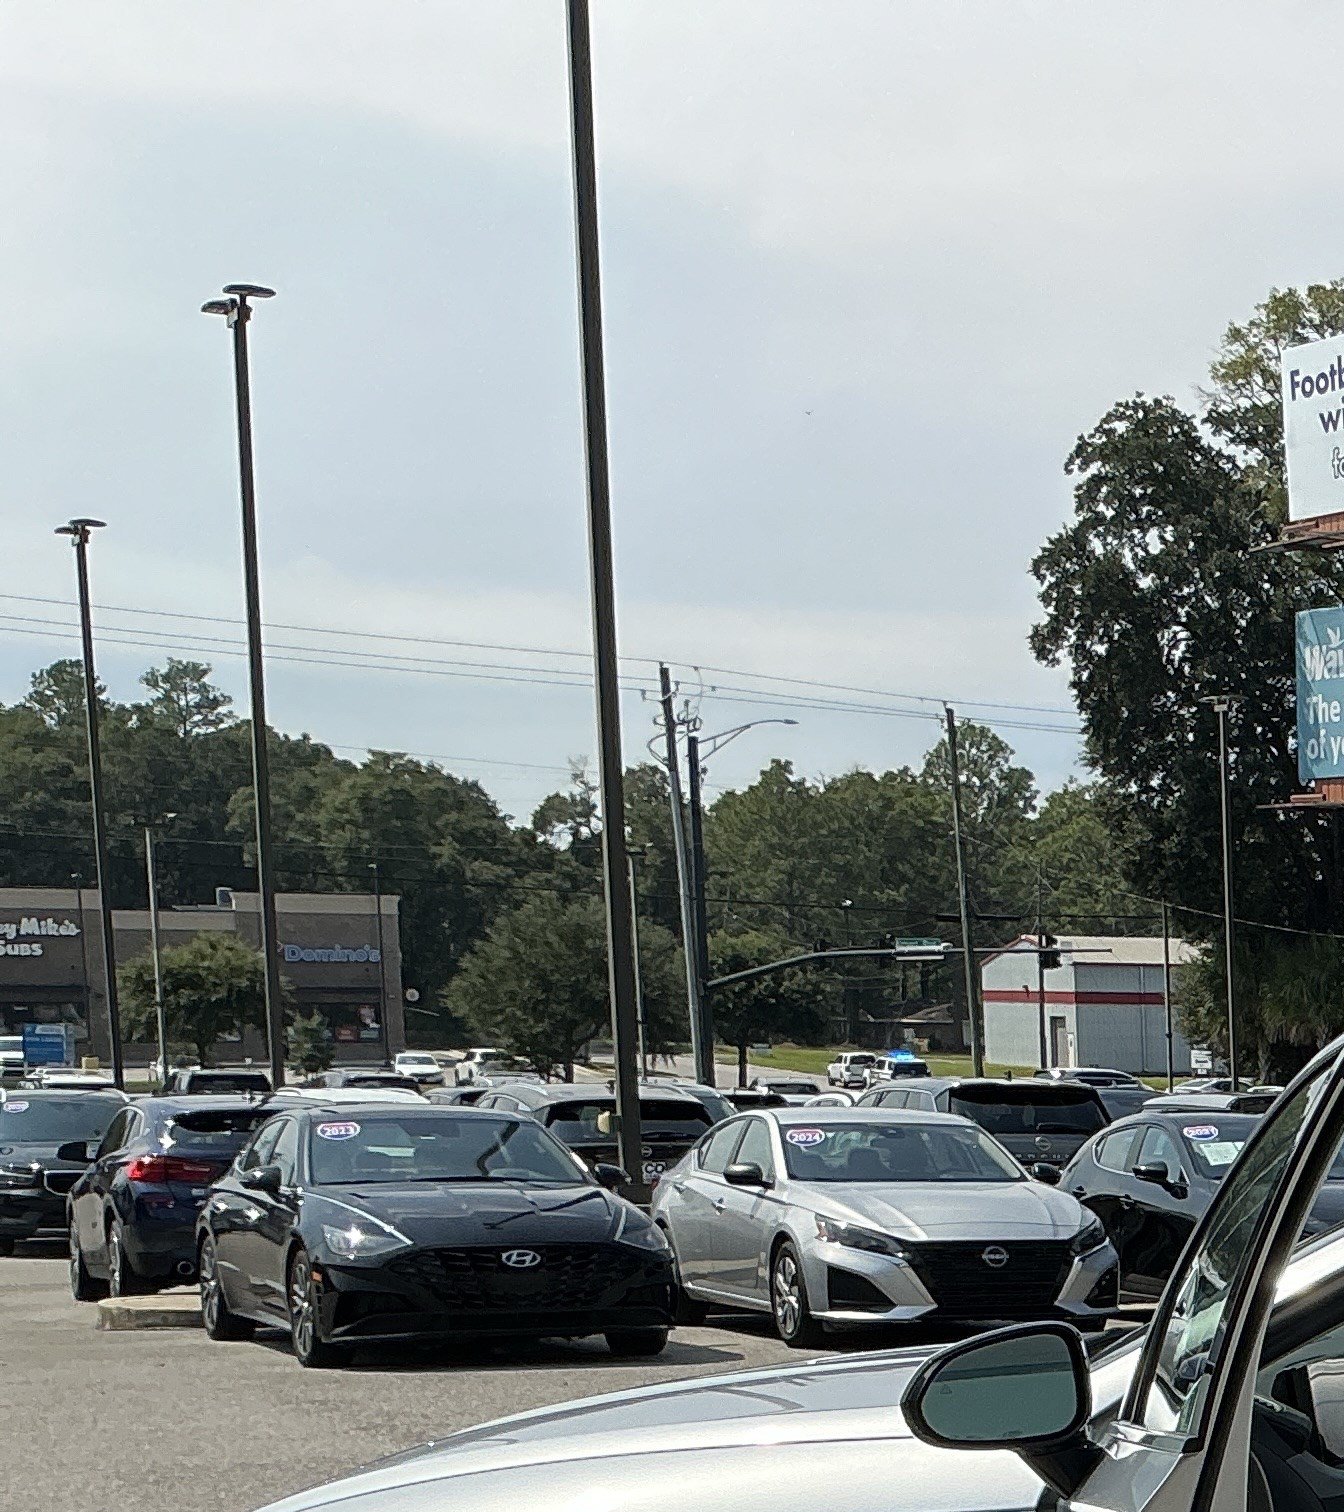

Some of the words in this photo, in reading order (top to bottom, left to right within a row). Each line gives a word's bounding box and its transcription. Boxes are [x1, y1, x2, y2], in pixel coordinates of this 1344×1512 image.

[1307, 693, 1341, 724] The
[1307, 728, 1326, 760] of
[284, 944, 380, 962] Domino's
[791, 1132, 820, 1142] 2024
